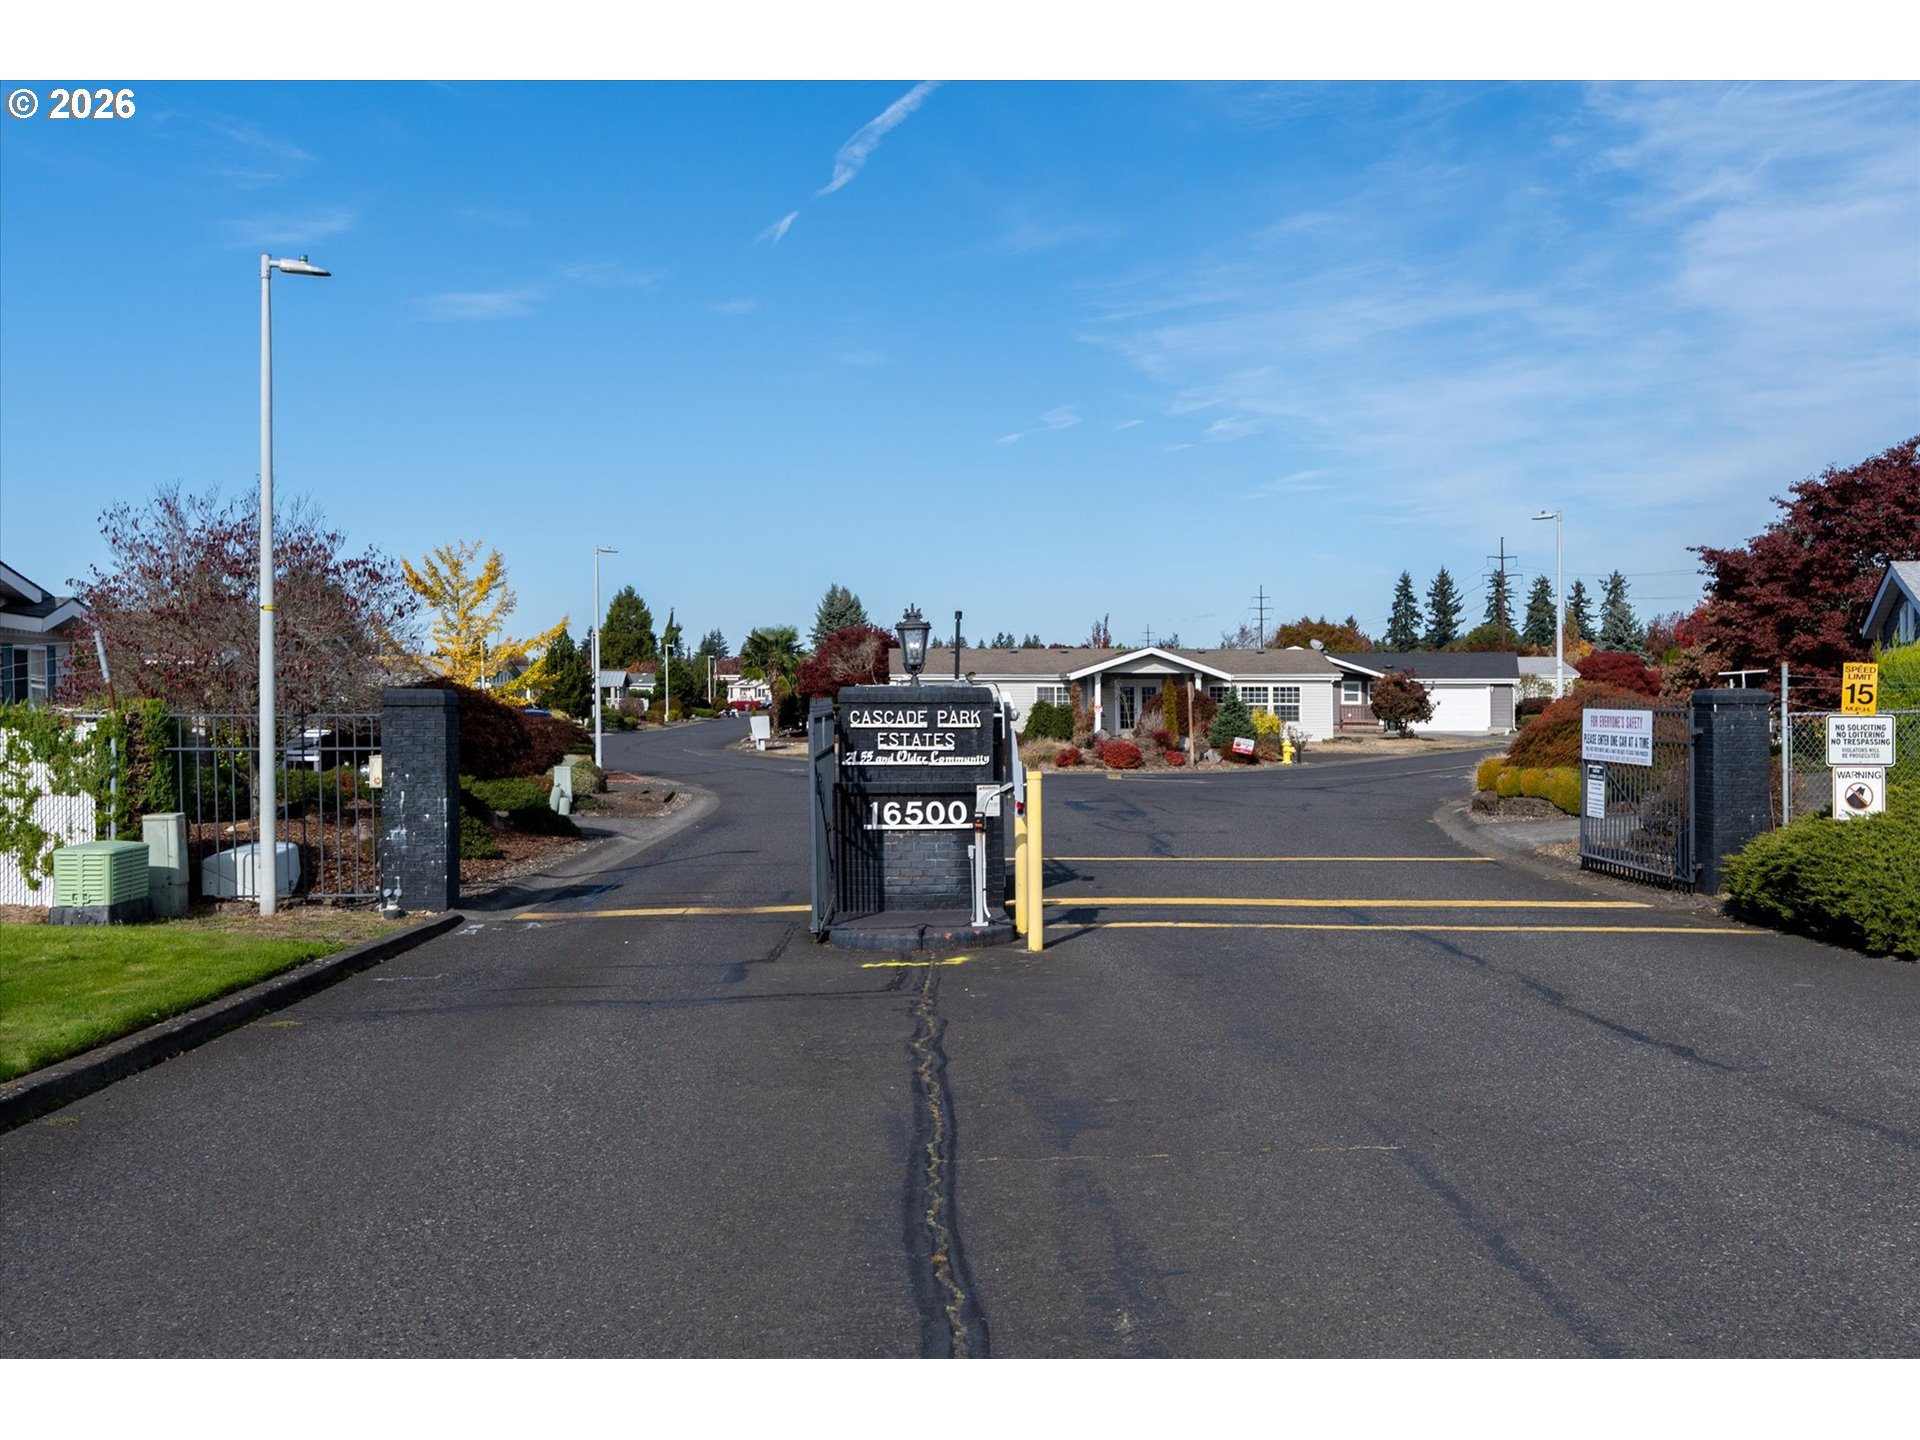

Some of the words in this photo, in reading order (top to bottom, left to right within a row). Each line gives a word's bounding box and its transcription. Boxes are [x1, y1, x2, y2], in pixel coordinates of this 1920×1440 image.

[1845, 683, 1874, 705] 15
[850, 710, 928, 726] CASCADE
[937, 710, 981, 726] PARK
[1590, 715, 1598, 728] FOR
[1626, 716, 1643, 729] SAFETY
[877, 733, 955, 748] ESTATES
[1584, 733, 1597, 745] PLEASE
[1598, 734, 1609, 746] ENTER
[1610, 735, 1618, 747] ONE
[1619, 735, 1627, 747] CAR
[1628, 736, 1634, 748] AT
[1639, 737, 1649, 749] TIME
[860, 751, 874, 763] 55
[875, 753, 894, 763] and
[896, 750, 928, 763] Older
[930, 750, 990, 764] Community
[1837, 771, 1882, 779] WARNING
[870, 801, 968, 826] 16500
